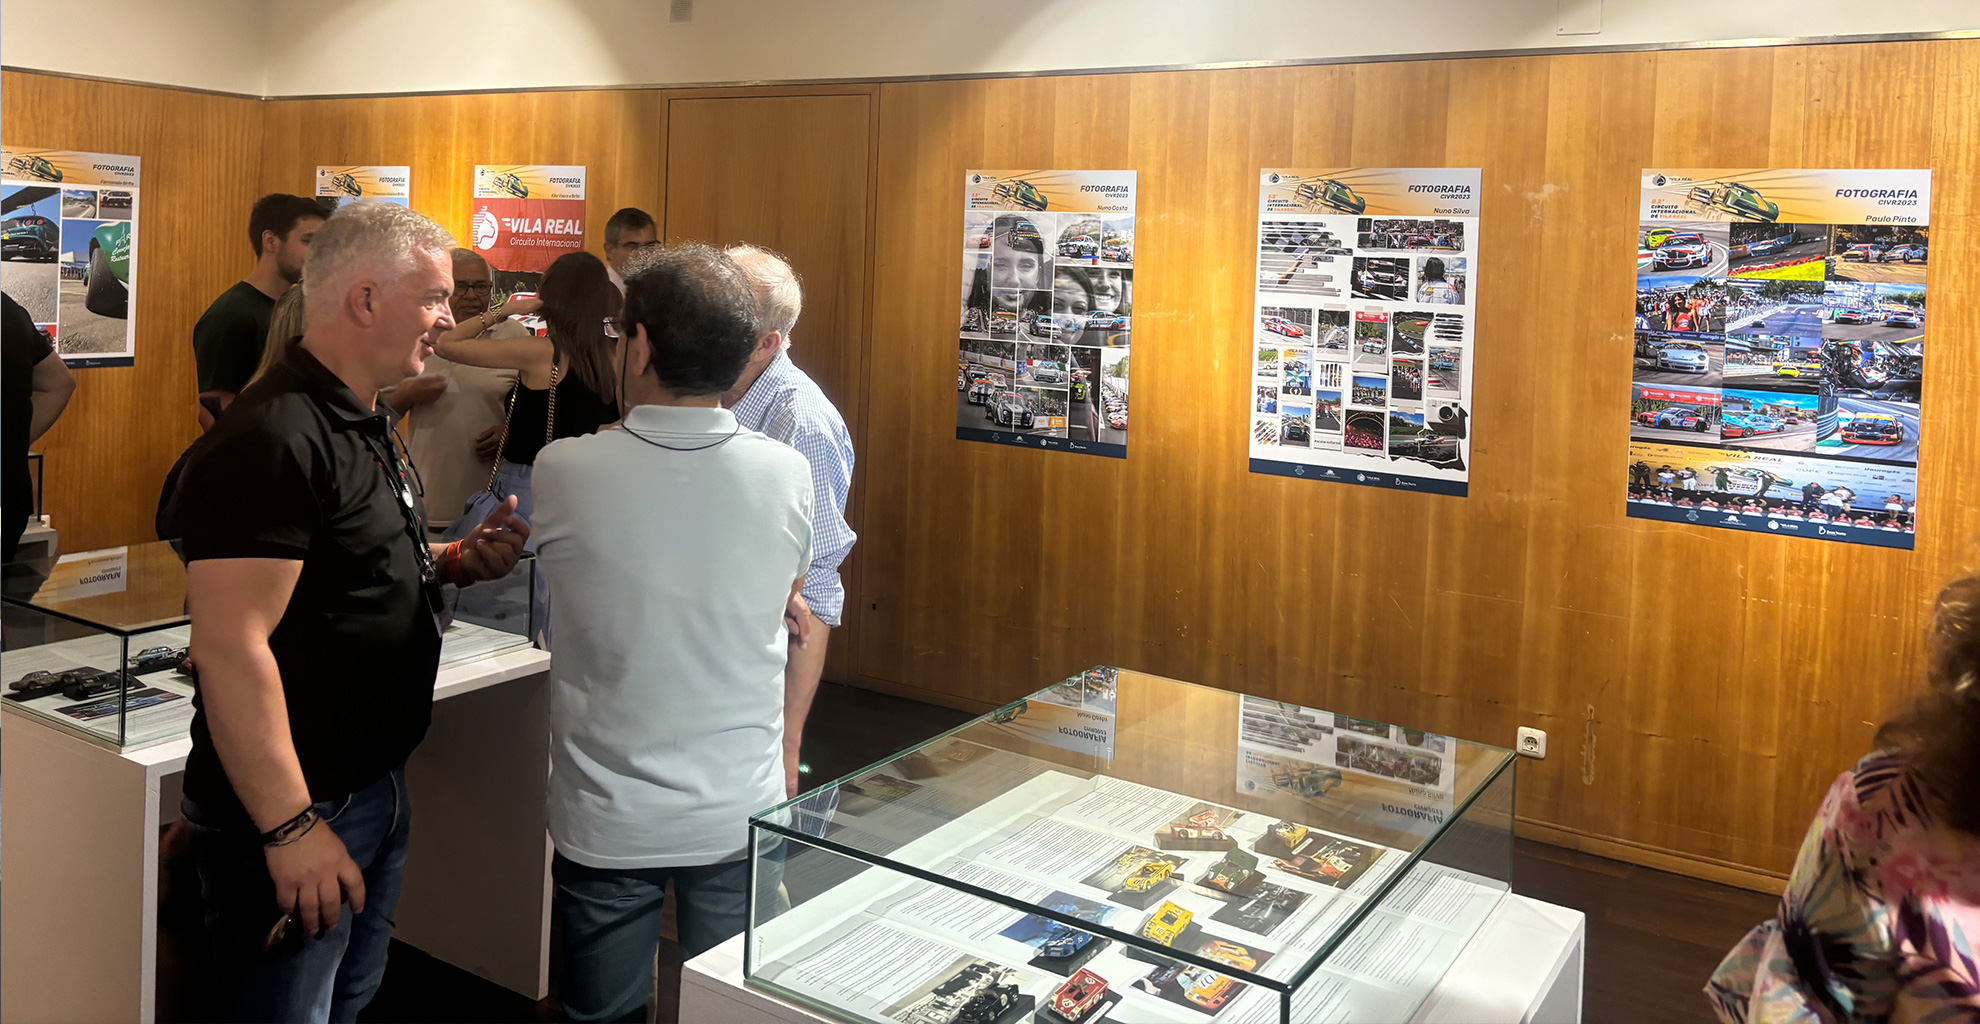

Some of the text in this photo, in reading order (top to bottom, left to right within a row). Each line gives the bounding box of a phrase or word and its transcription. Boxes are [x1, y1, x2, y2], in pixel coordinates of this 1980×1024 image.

[93, 164, 134, 173] FOTOGRAFIA
[1080, 185, 1129, 193] FOTOGRAFIA
[1408, 185, 1471, 193] FOTOGRAFIA
[1835, 189, 1918, 198] FOTOGRAFIA
[1892, 215, 1917, 223] Pinto
[511, 218, 583, 235] VILA REAL
[510, 237, 582, 248] Circuito Internacional
[1754, 455, 1784, 463] REAL
